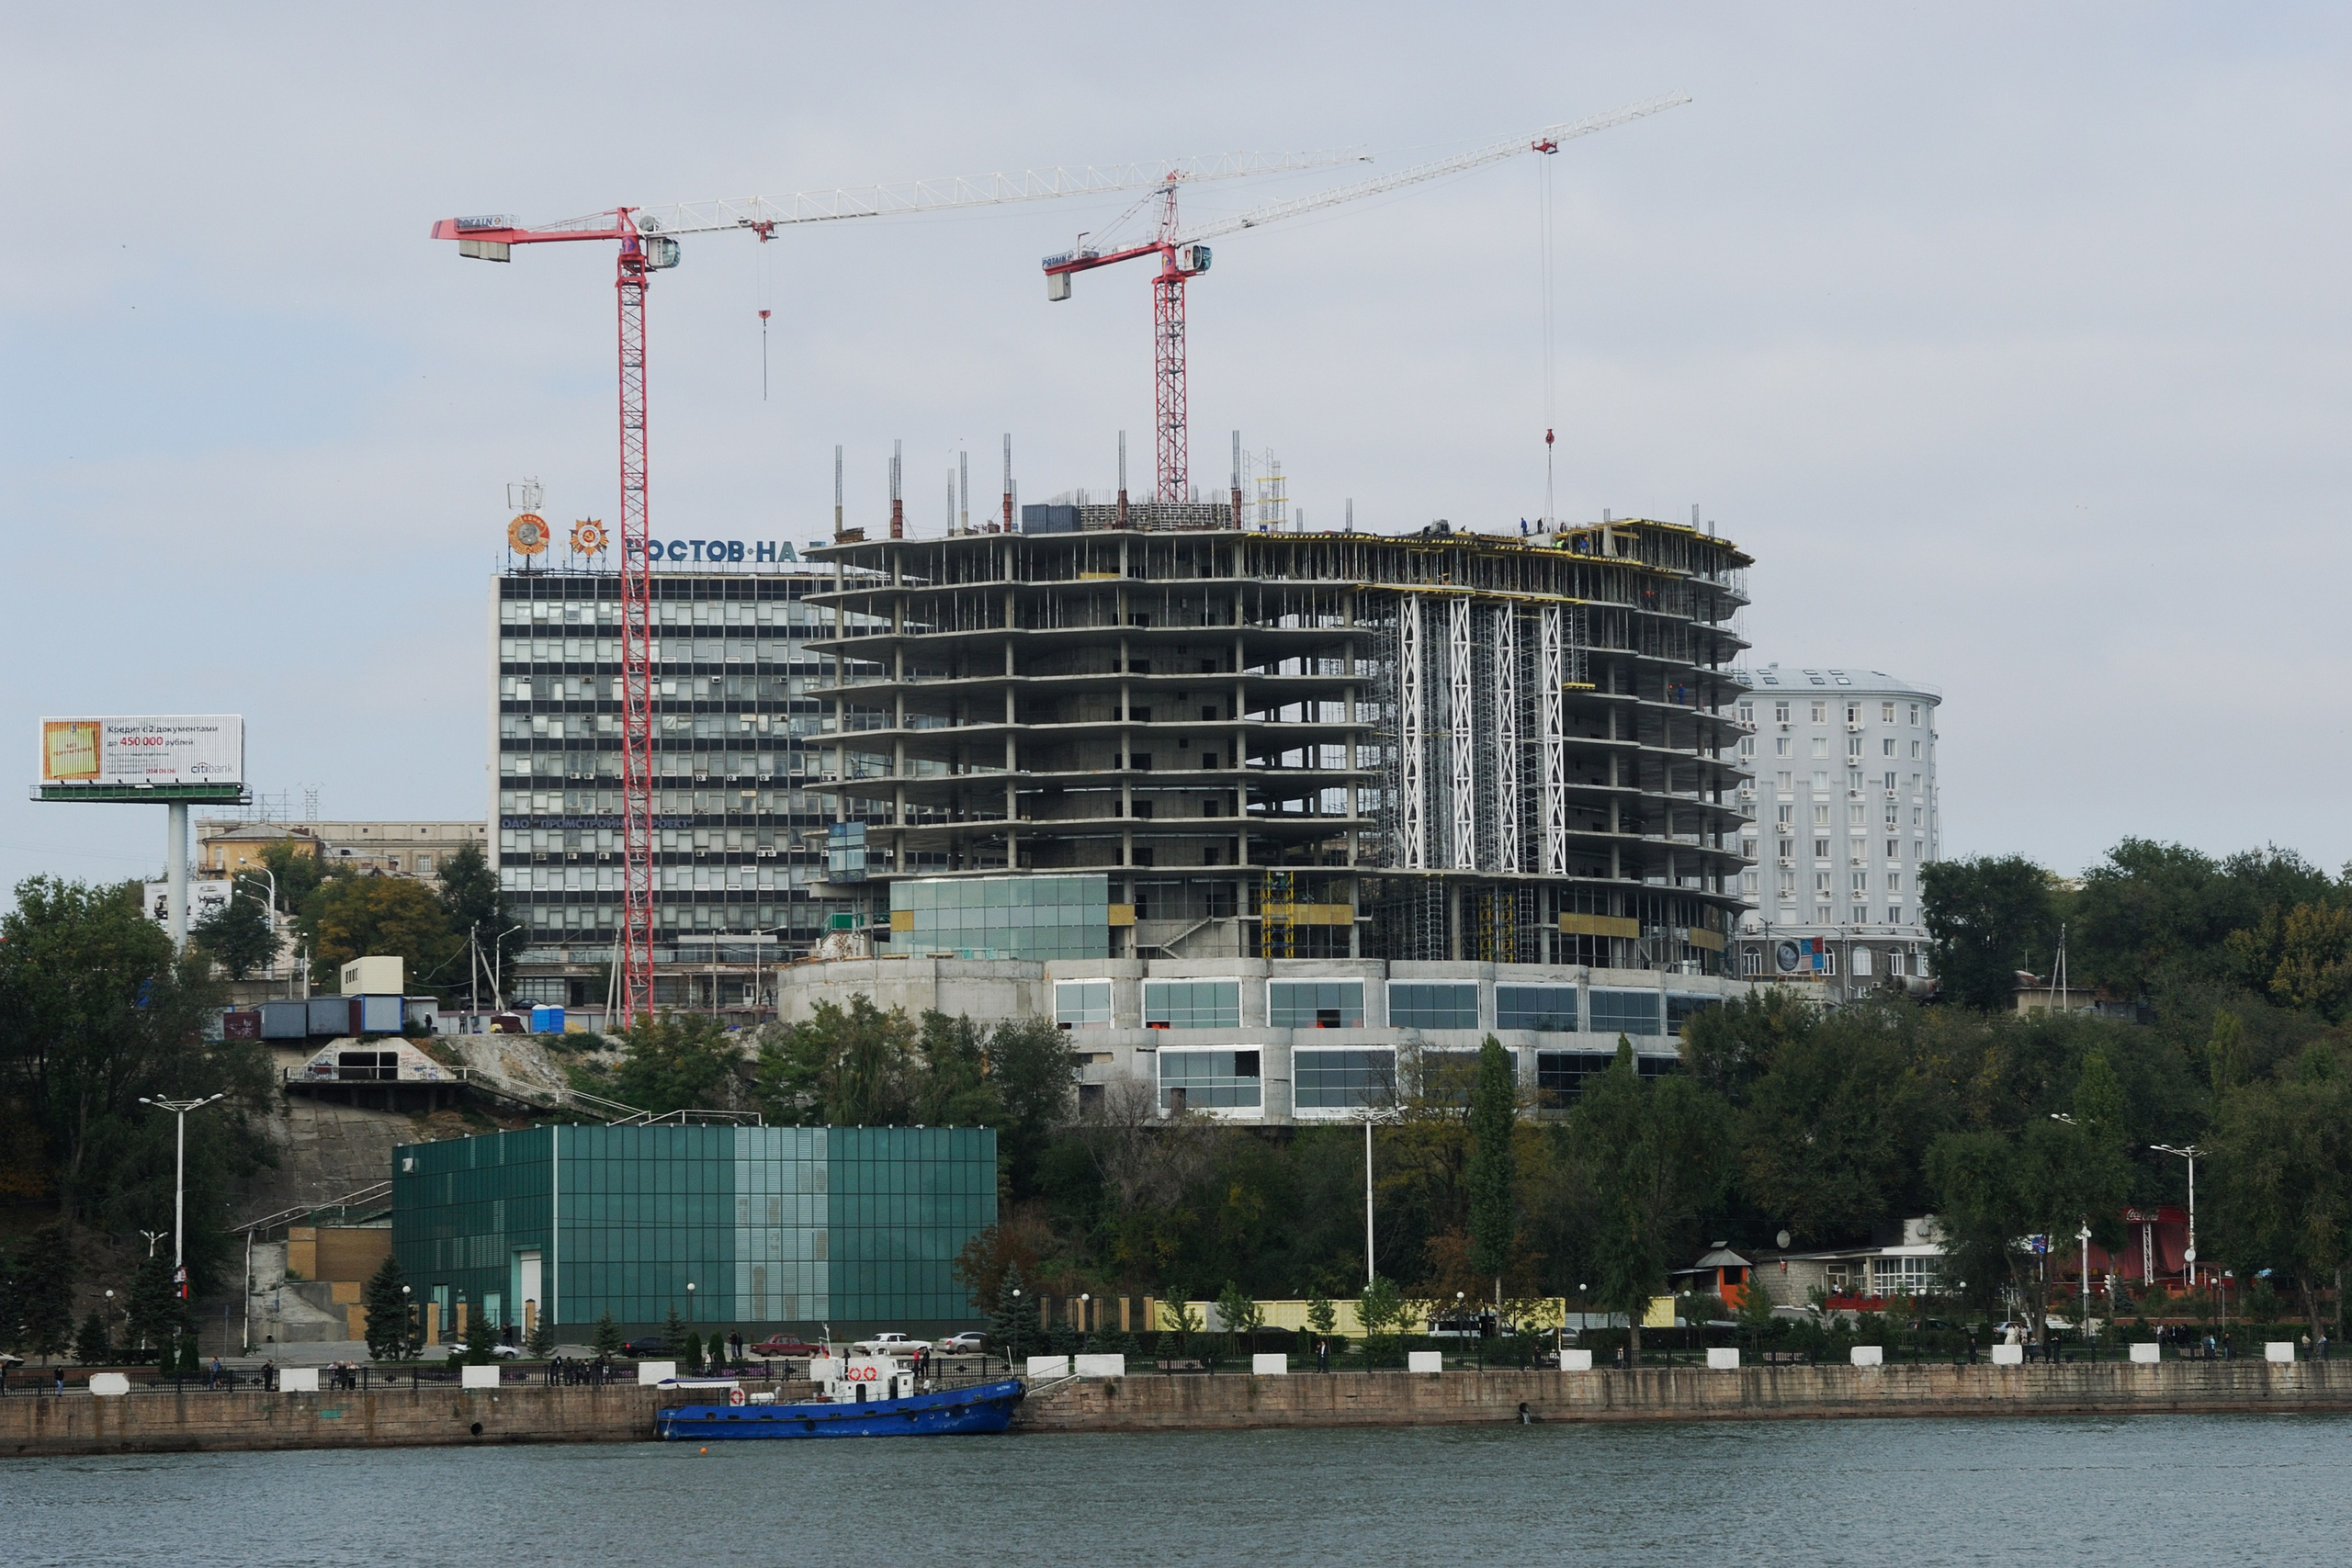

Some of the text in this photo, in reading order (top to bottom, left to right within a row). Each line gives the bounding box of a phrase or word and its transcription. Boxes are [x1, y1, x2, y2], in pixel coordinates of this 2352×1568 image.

[1042, 254, 1067, 267] POTAIN
[107, 726, 140, 734] Кредит
[120, 737, 141, 746] 450
[143, 736, 164, 746] 000
[191, 762, 233, 773] citibank
[502, 818, 530, 829] ОАО
